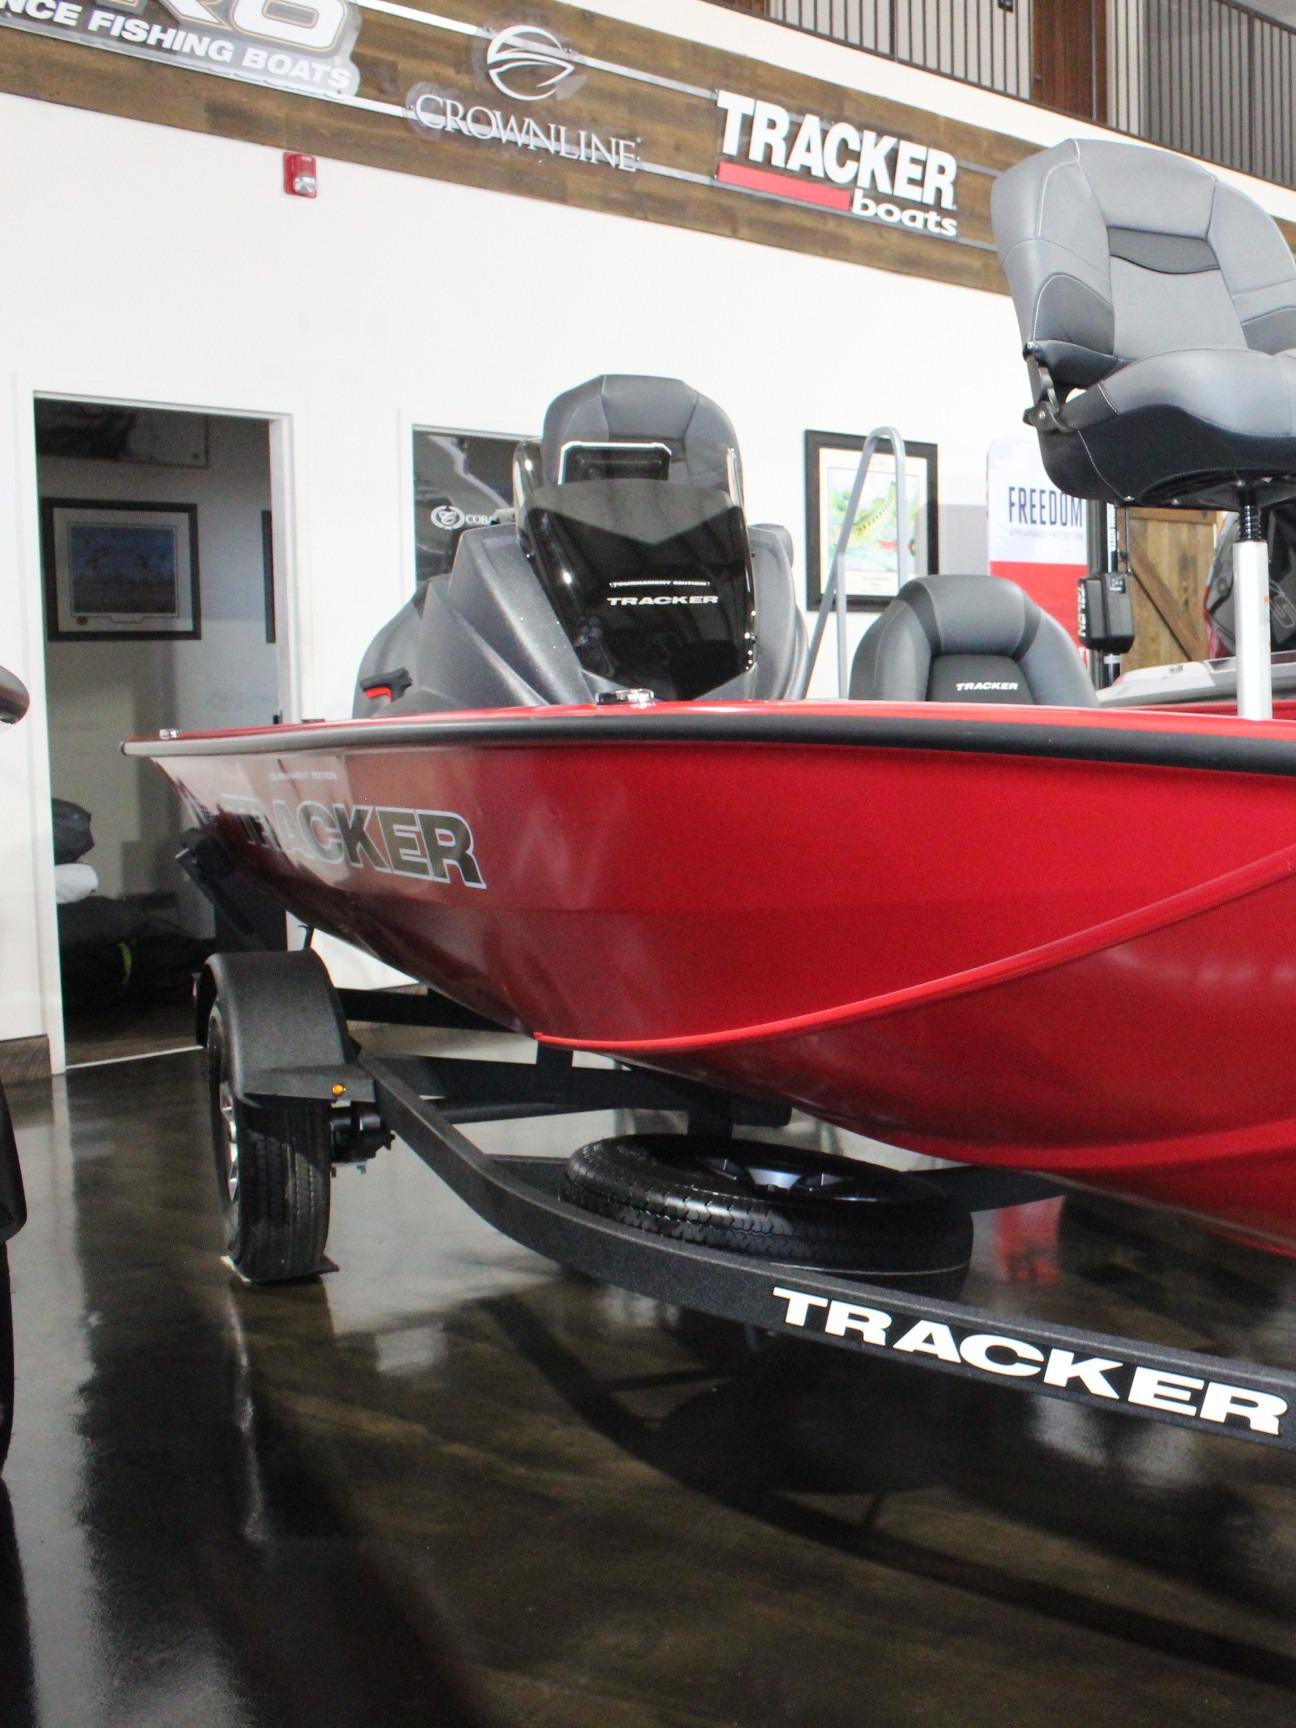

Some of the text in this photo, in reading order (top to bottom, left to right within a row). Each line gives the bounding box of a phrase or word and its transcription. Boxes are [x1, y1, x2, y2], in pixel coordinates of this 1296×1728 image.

[87, 9, 234, 63] FISHING
[242, 47, 352, 89] BOATS
[415, 94, 637, 172] CROWNLINE
[717, 89, 957, 211] TRACKER
[852, 188, 957, 236] boats
[1008, 486, 1083, 528] FREEDOM
[606, 595, 719, 606] TRACKER
[955, 681, 1019, 692] TRACKER
[772, 1286, 1289, 1436] TRACKER
